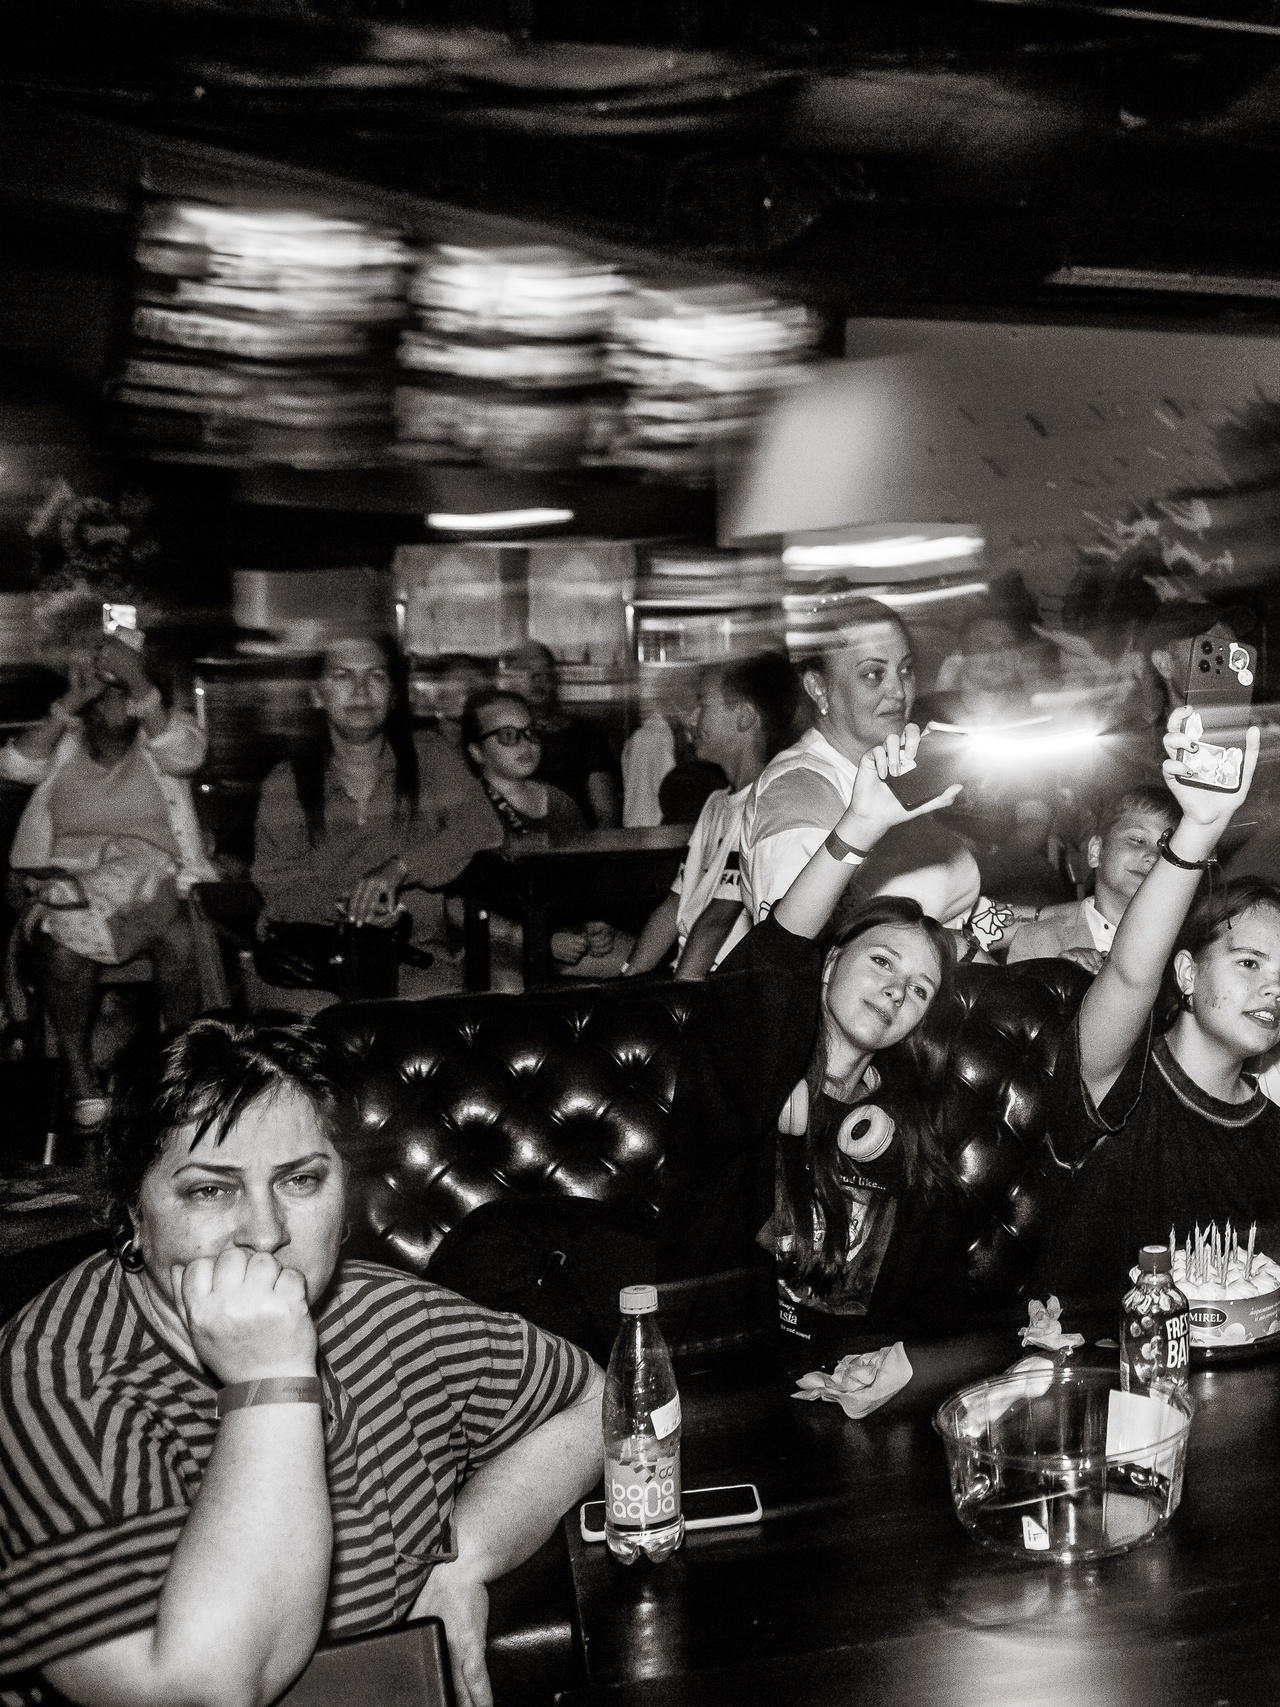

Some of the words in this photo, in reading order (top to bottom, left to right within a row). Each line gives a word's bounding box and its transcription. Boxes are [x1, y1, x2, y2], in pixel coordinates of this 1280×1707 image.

[1189, 1312, 1223, 1323] MIREL
[612, 1478, 675, 1502] bona
[612, 1495, 675, 1523] aqua
